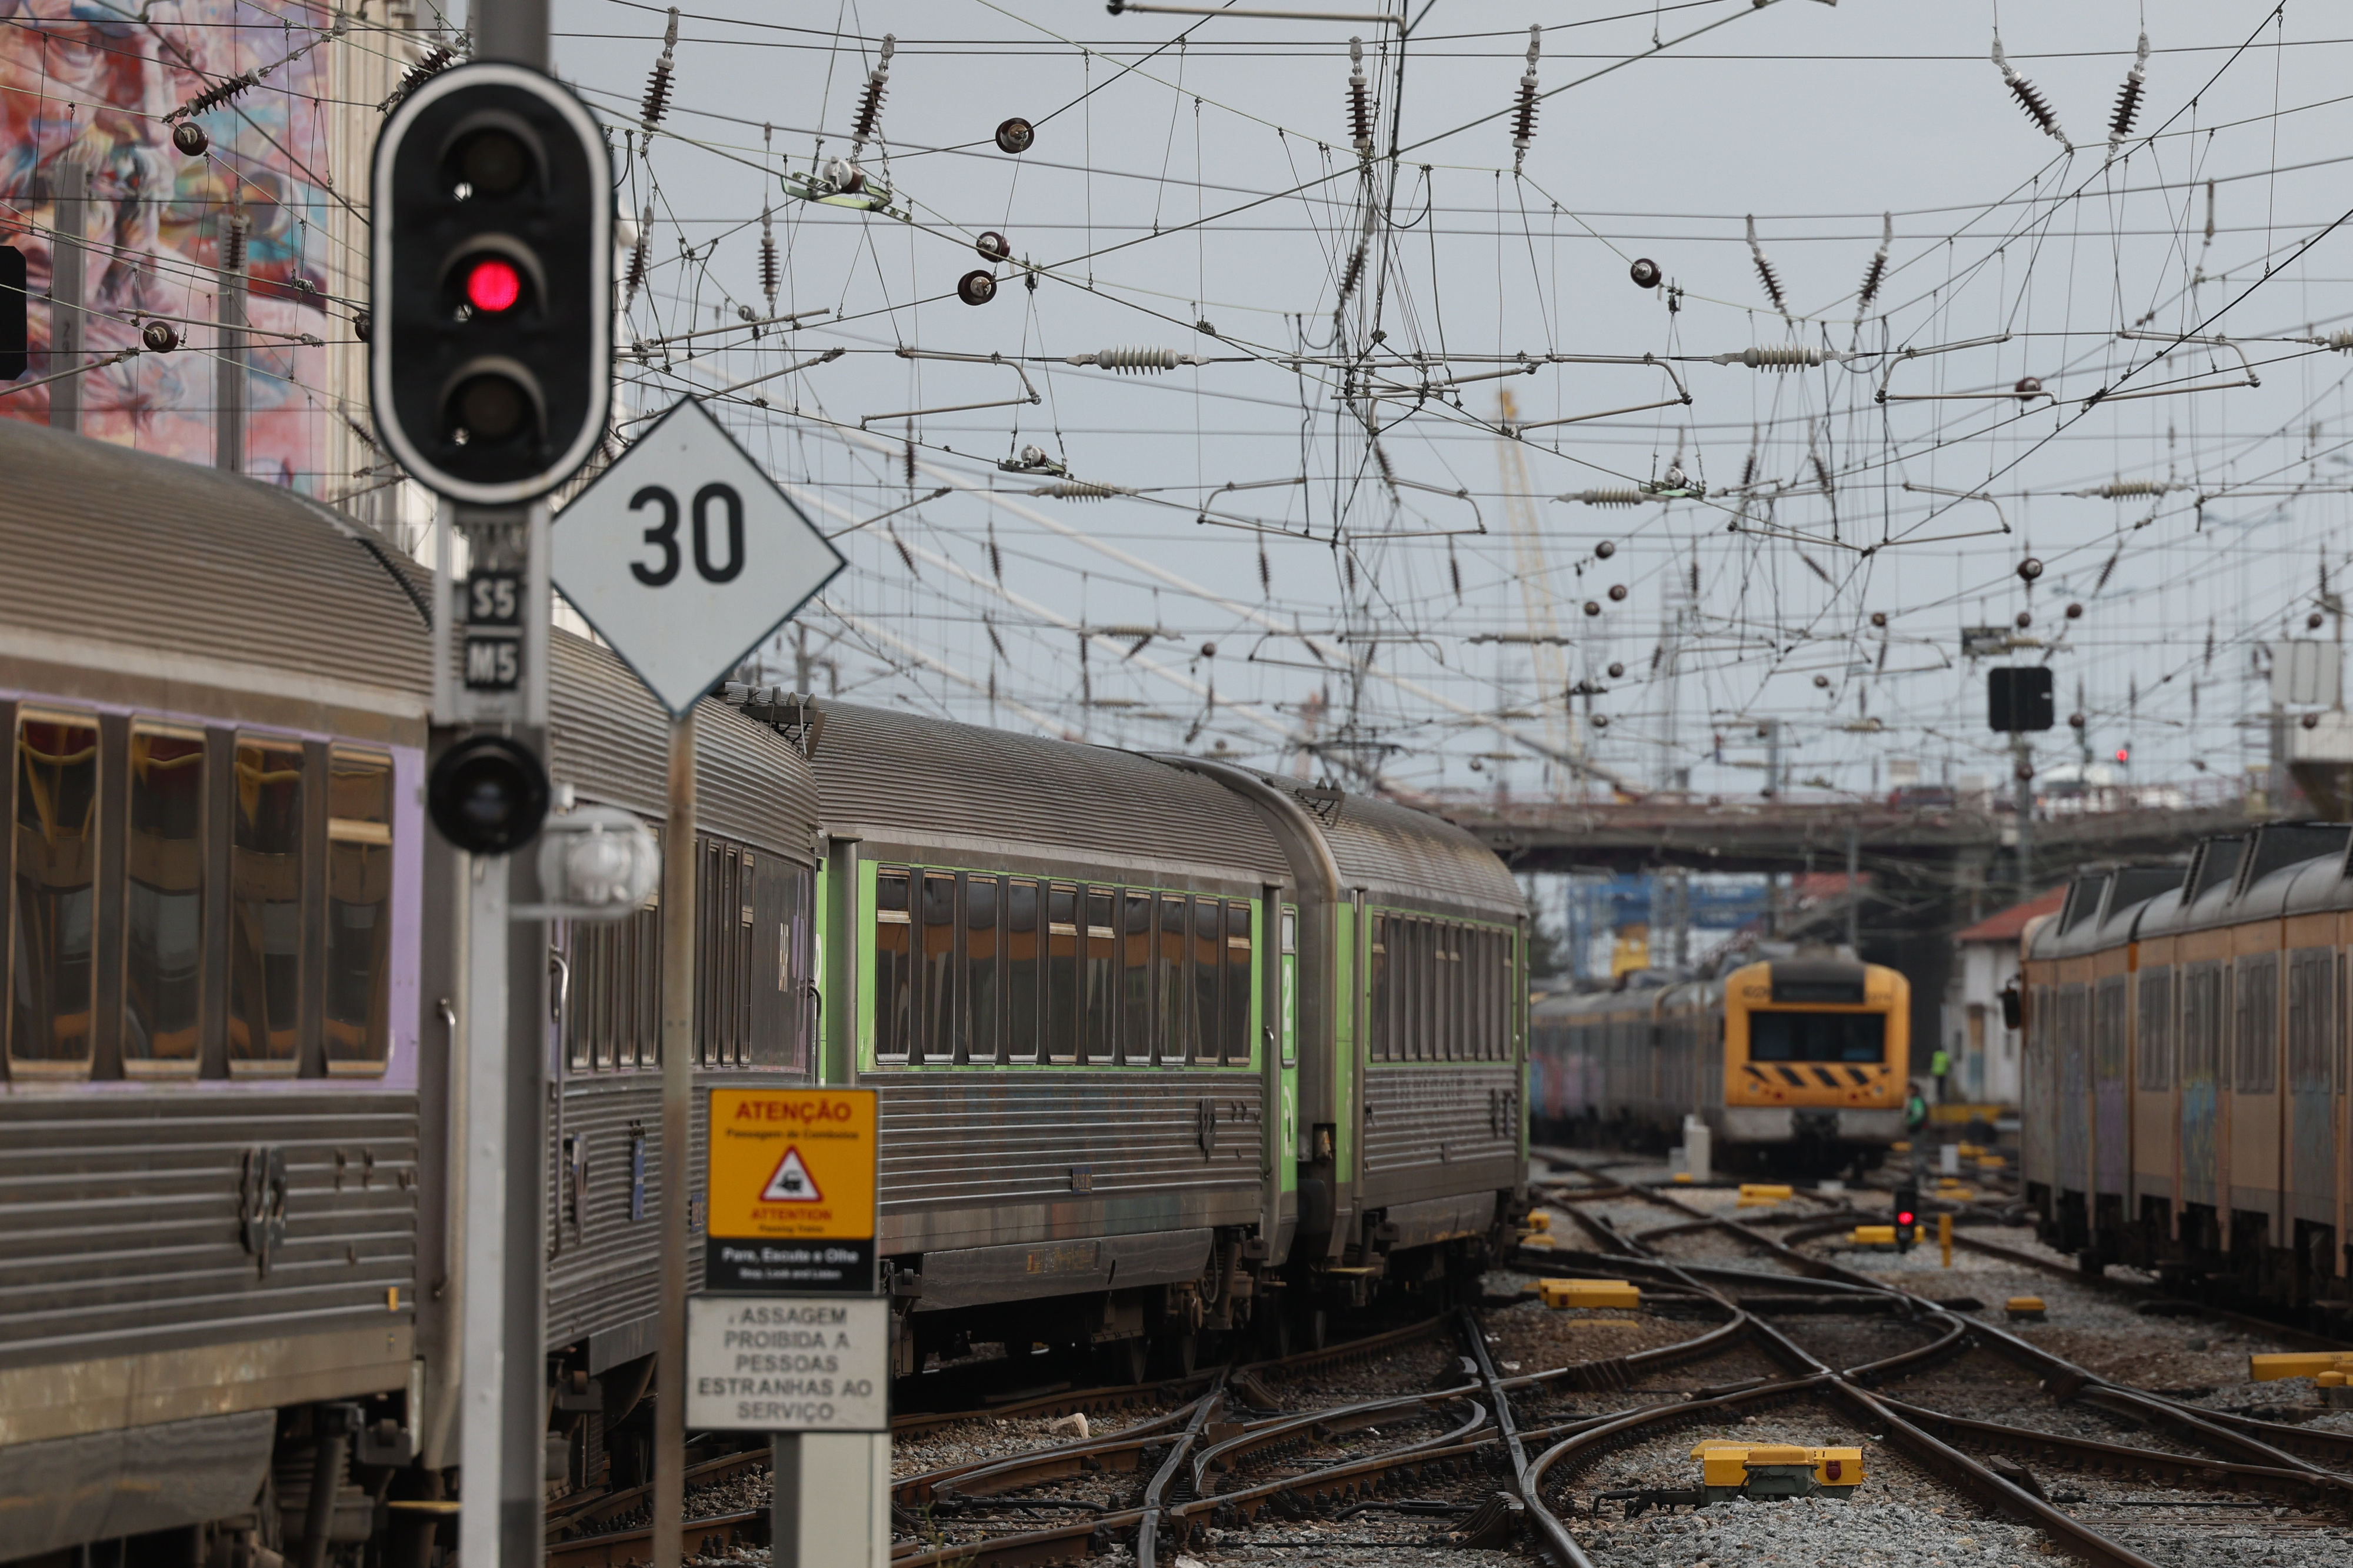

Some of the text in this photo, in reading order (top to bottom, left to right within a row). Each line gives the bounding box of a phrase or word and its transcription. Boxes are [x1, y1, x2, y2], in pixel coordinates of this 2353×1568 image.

[628, 481, 745, 588] 30
[472, 578, 516, 618] S5
[469, 643, 518, 683] M5
[779, 923, 789, 993] BAR
[736, 1097, 853, 1125] ATENÇÃO
[751, 1207, 833, 1221] ATTENTION
[761, 1247, 811, 1263] Escute
[812, 1251, 823, 1263] e
[824, 1247, 859, 1263] Olhe
[728, 1306, 848, 1324] ASSAGEM
[724, 1330, 851, 1349] PROIBIDA A
[735, 1354, 839, 1373] PESSOAS
[698, 1377, 873, 1398] ESTRANHAS AO
[737, 1402, 834, 1424] SERVIÇO
